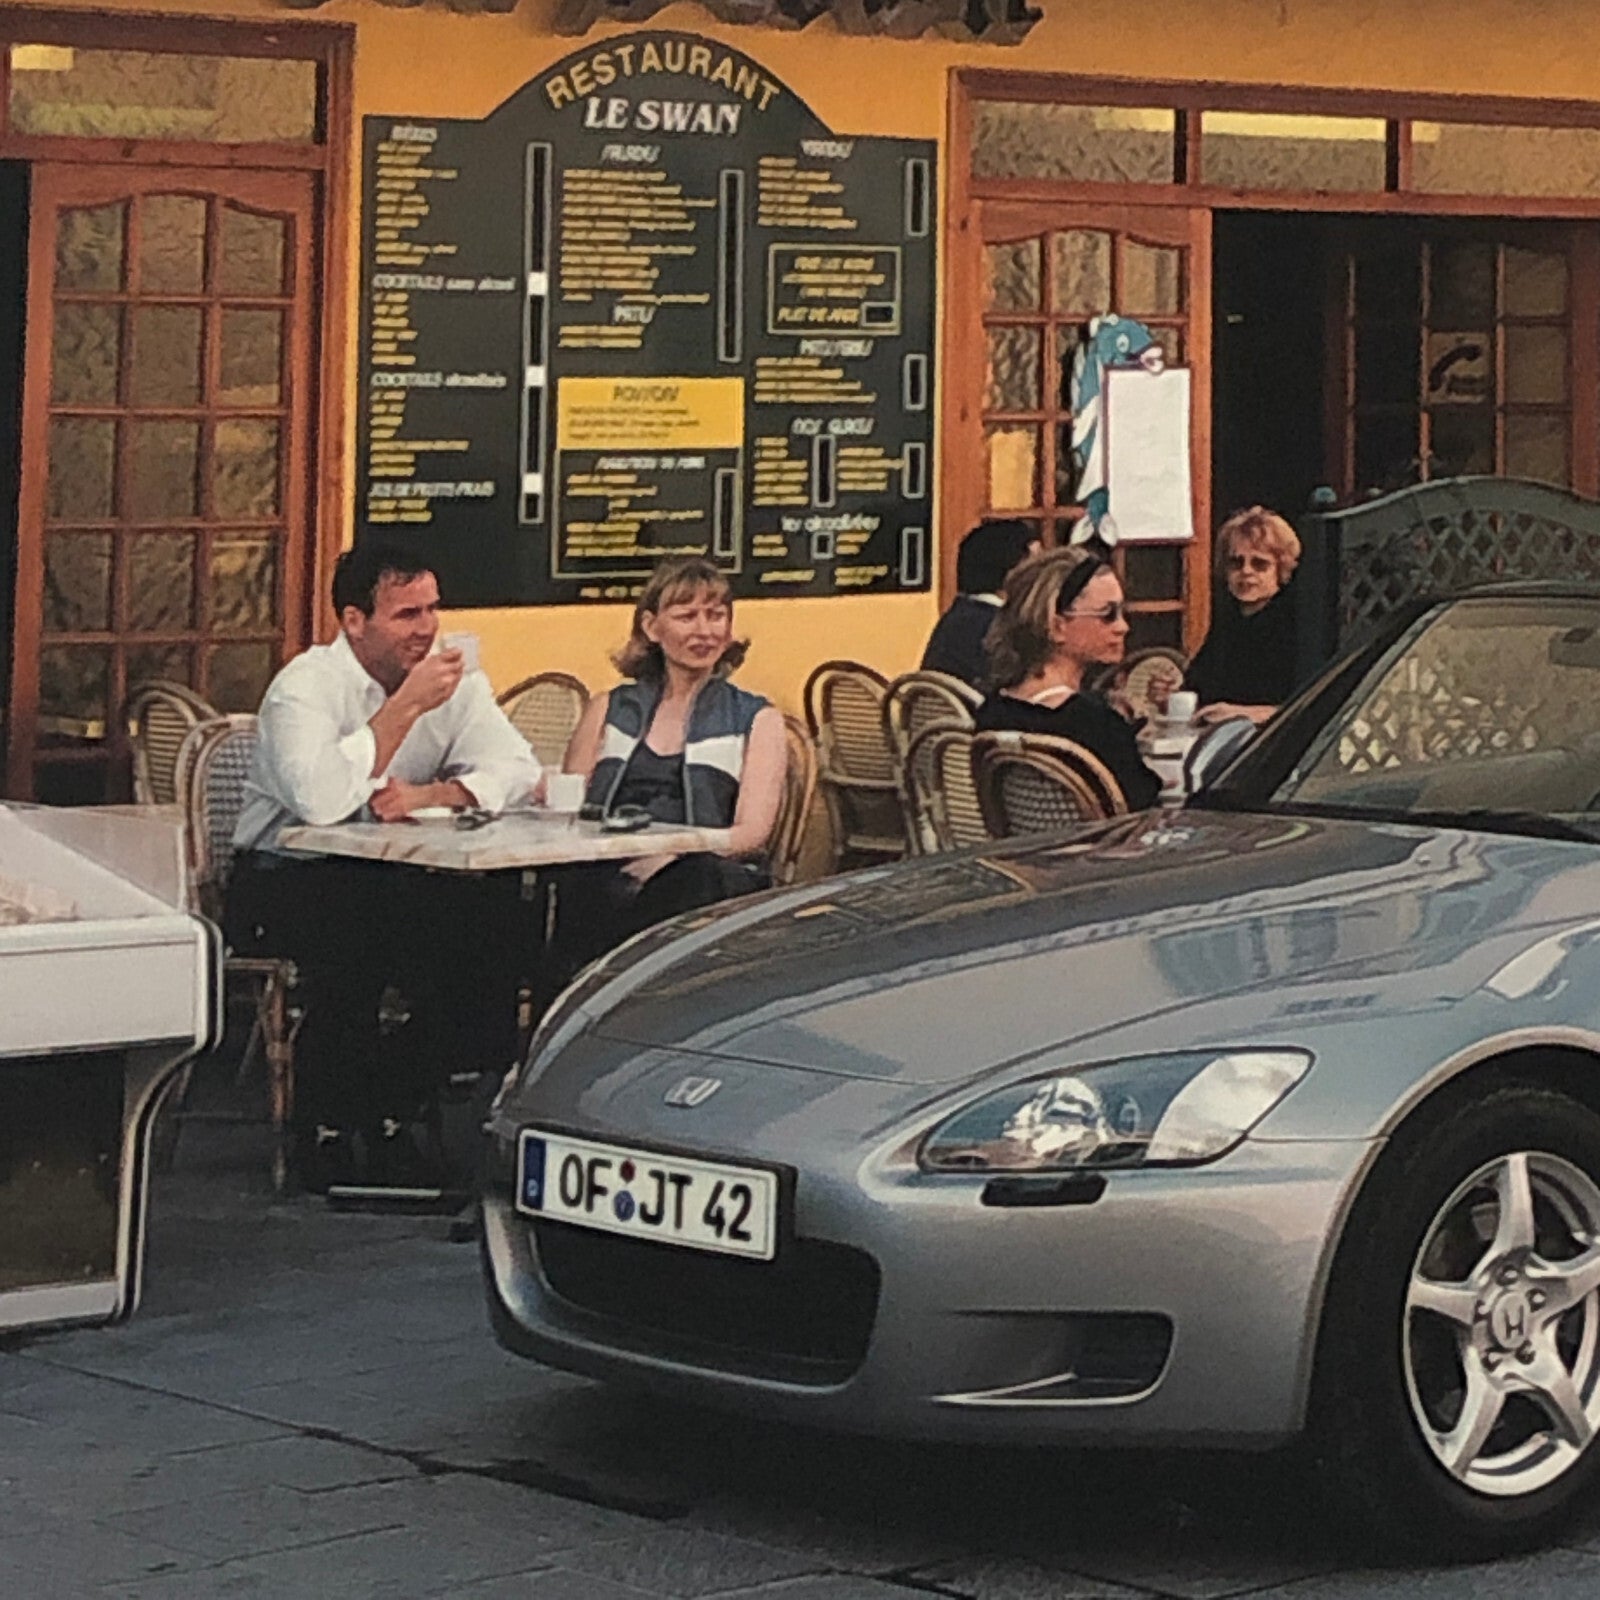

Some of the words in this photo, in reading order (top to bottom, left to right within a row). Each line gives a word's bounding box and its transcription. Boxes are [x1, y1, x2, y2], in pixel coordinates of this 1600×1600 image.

[545, 40, 780, 111] RESTAURANT
[584, 97, 629, 129] LE
[634, 101, 742, 135] SWAN
[559, 1153, 612, 1213] OF
[639, 1170, 692, 1229] JT
[703, 1180, 752, 1242] 42
